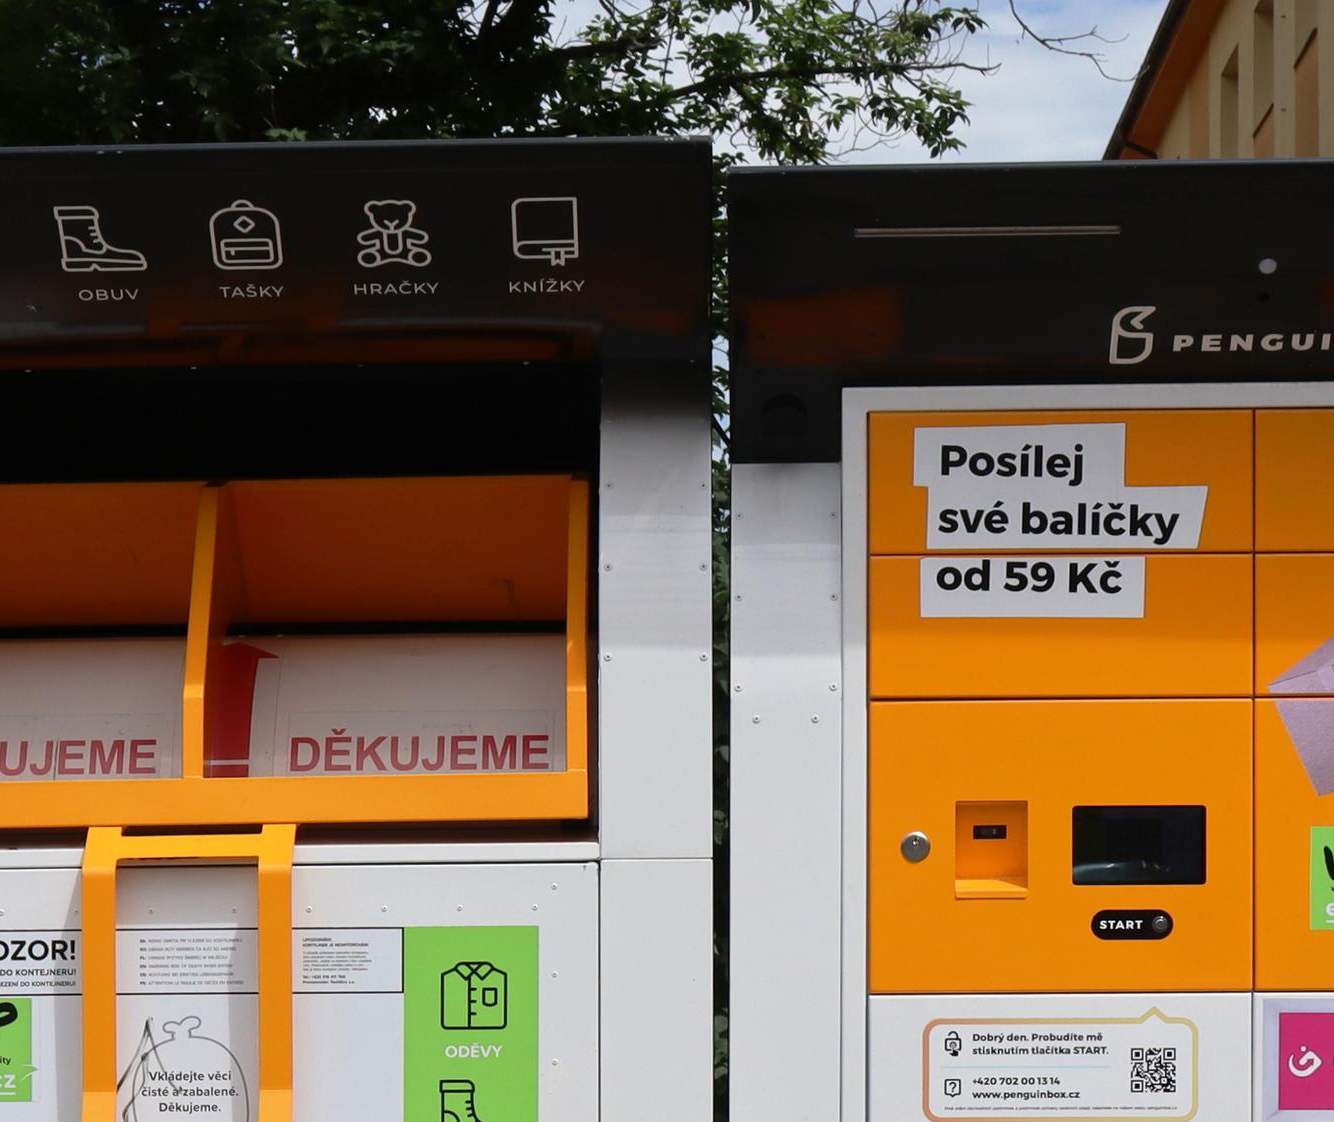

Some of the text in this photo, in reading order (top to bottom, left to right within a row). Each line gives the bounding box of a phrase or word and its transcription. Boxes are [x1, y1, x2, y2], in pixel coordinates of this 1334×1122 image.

[219, 283, 284, 300] TAŠKY
[353, 279, 439, 297] HRAČKY
[508, 276, 585, 295] KNÍŽKY
[78, 288, 139, 302] OBUV
[940, 443, 1084, 487] Posílej
[938, 500, 1181, 546] své balíčky
[936, 559, 1123, 594] od 59 Kč
[288, 728, 550, 772] DĚKUJEME
[1099, 919, 1143, 930] START
[972, 1033, 1103, 1044] Dobrý den. Probudíte mě
[445, 1043, 502, 1059] ODĚVY
[972, 1046, 1109, 1056] stisknutím tlačítka START.
[149, 1069, 232, 1083] Vkládejte věci
[972, 1077, 1060, 1086] +420 702 00 13 14
[141, 1084, 239, 1097] čisté a zabalené.
[972, 1089, 1080, 1101] www.penguinbox.cz
[158, 1101, 222, 1114] Děkujeme.
